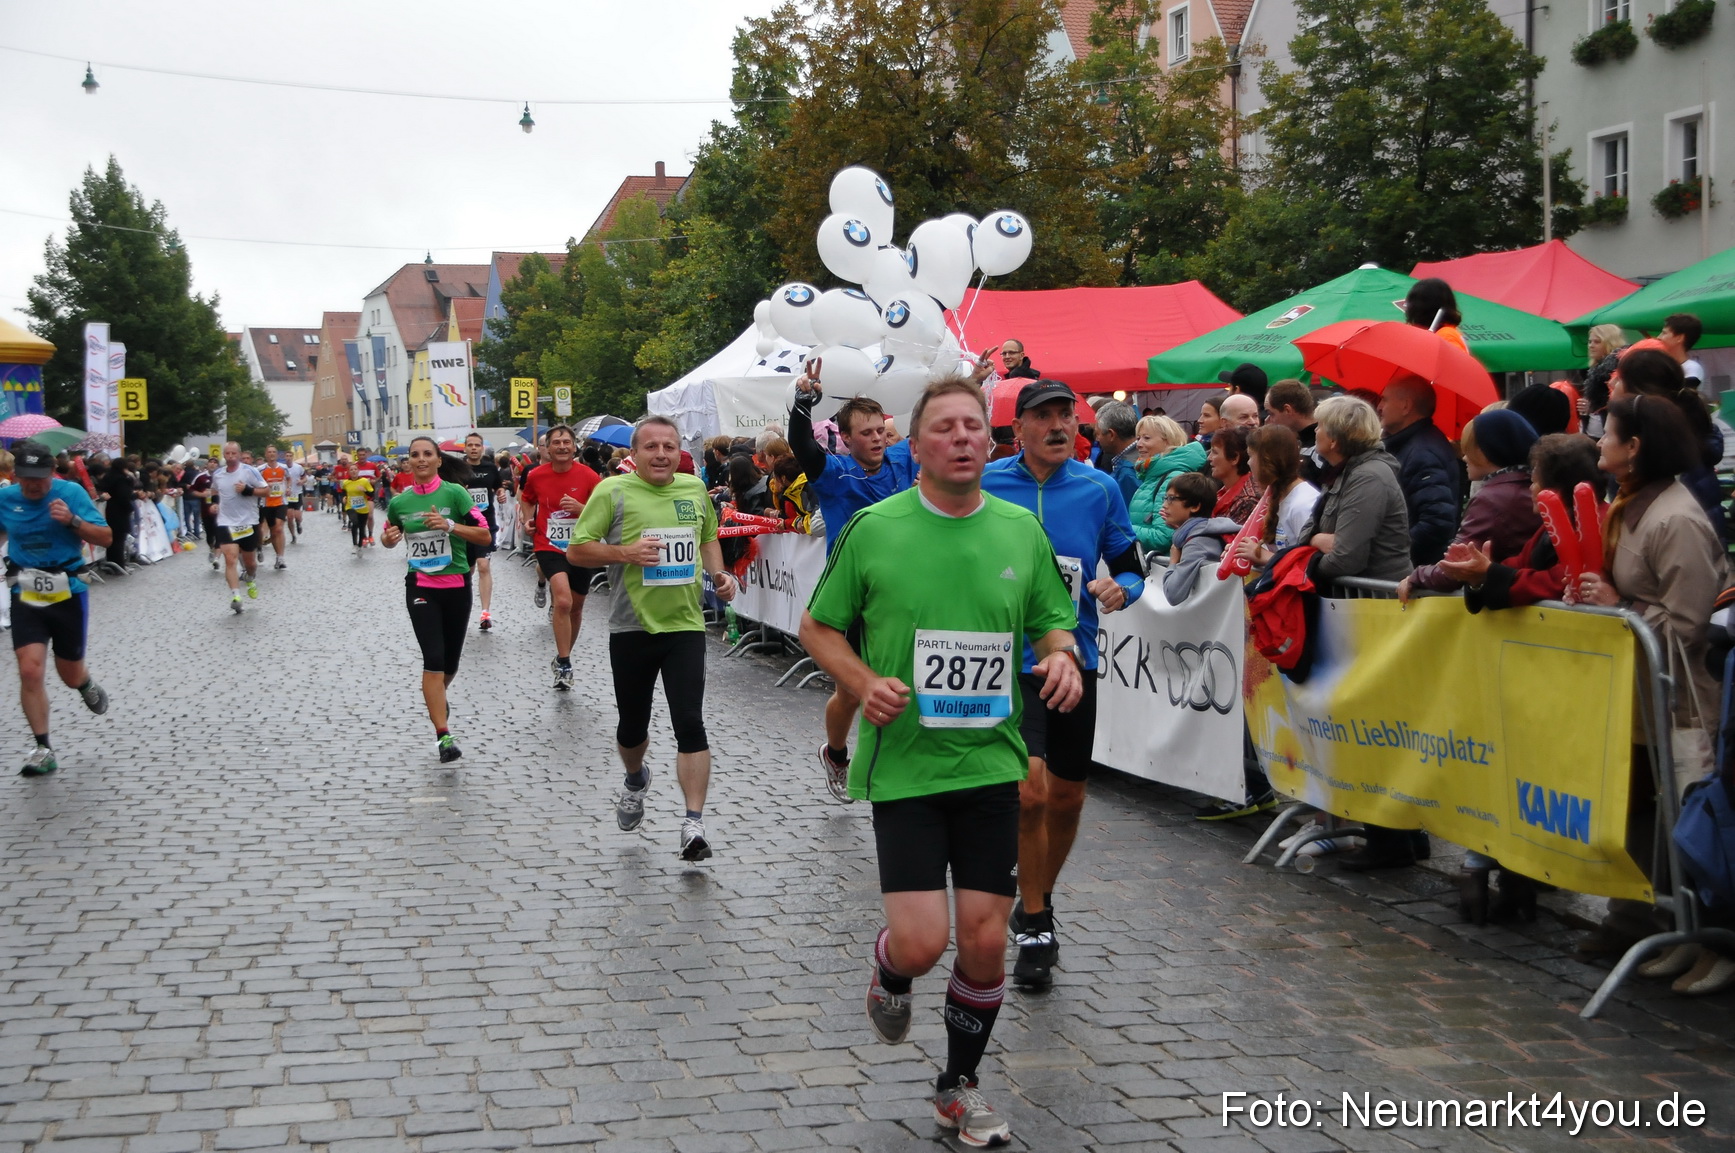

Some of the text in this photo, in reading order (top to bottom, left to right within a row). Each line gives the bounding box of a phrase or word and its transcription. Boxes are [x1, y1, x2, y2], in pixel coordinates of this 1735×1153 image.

[514, 380, 535, 388] Block
[125, 391, 140, 411] B
[518, 390, 531, 409] B
[719, 525, 760, 536] Audi BKK
[412, 539, 445, 557] 2947
[666, 540, 694, 563] 100
[656, 567, 689, 578] Reinhold
[34, 576, 54, 592] 65
[917, 639, 1001, 652] PARTL Neumarkt
[1097, 628, 1158, 694] BKK
[924, 654, 1005, 691] 2872
[933, 699, 991, 717] Wolfgang
[1515, 777, 1592, 845] KANN
